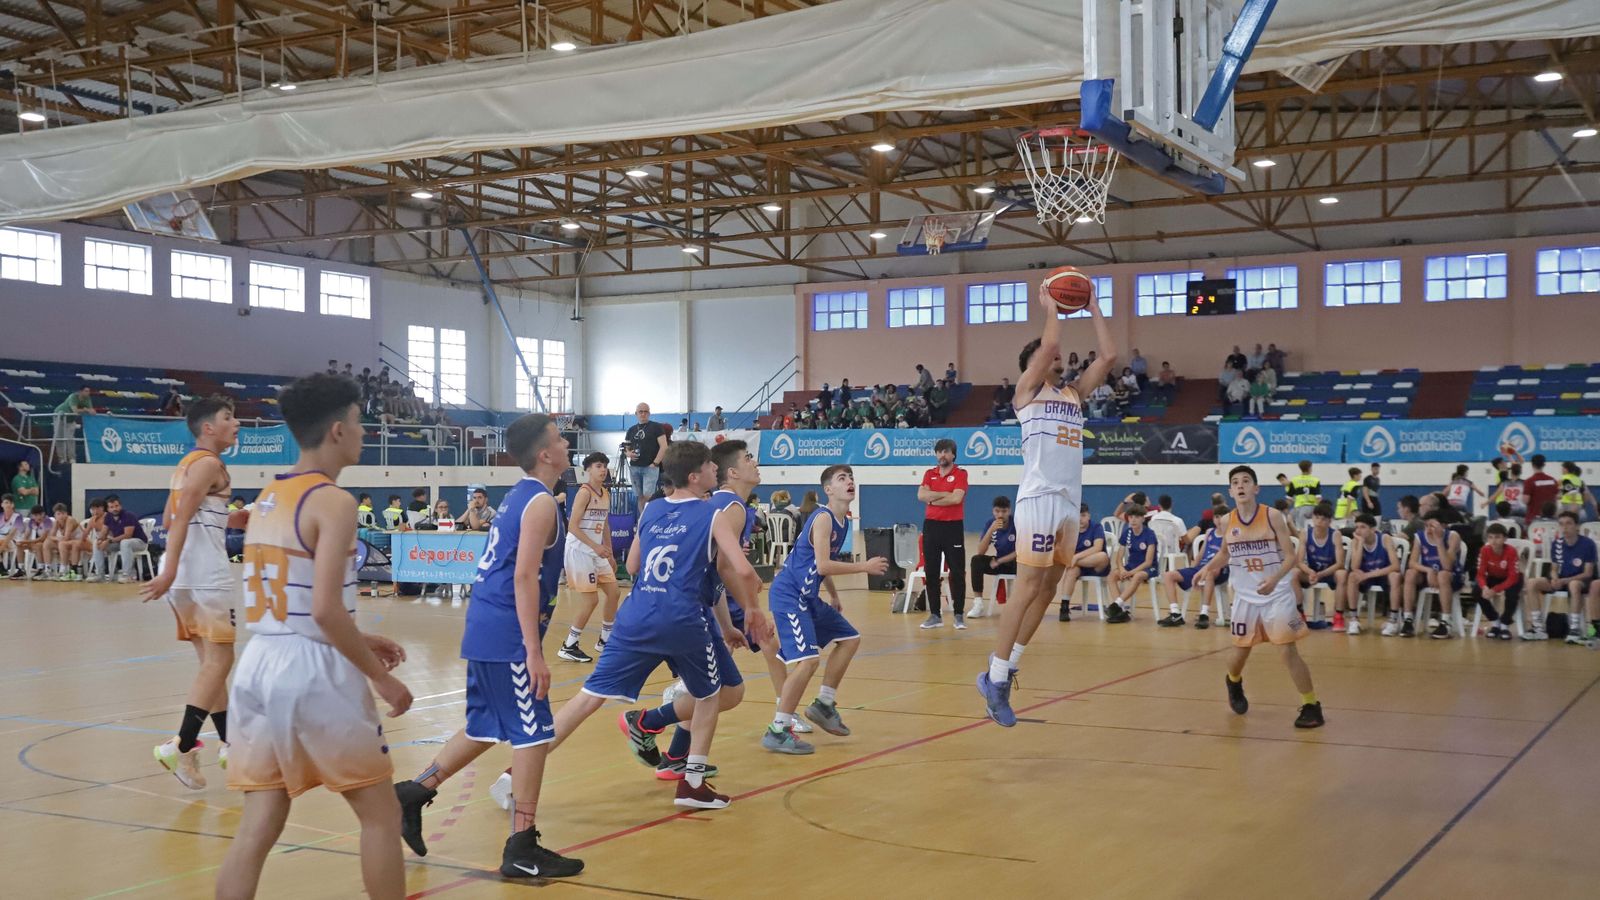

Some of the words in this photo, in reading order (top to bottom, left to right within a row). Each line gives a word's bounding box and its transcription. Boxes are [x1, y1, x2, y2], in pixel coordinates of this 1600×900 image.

[1044, 400, 1081, 418] GRANA
[125, 431, 162, 443] BASKET
[1056, 425, 1081, 449] 22
[1270, 431, 1331, 444] baloncesto
[1400, 429, 1466, 441] baloncesto
[798, 437, 845, 448] baloncesto
[127, 443, 185, 455] SOSTENIBLE
[1032, 533, 1055, 553] 22
[1230, 541, 1270, 553] GRANADA
[409, 545, 475, 565] deportes
[588, 573, 597, 584] 6
[1231, 621, 1247, 637] 10
